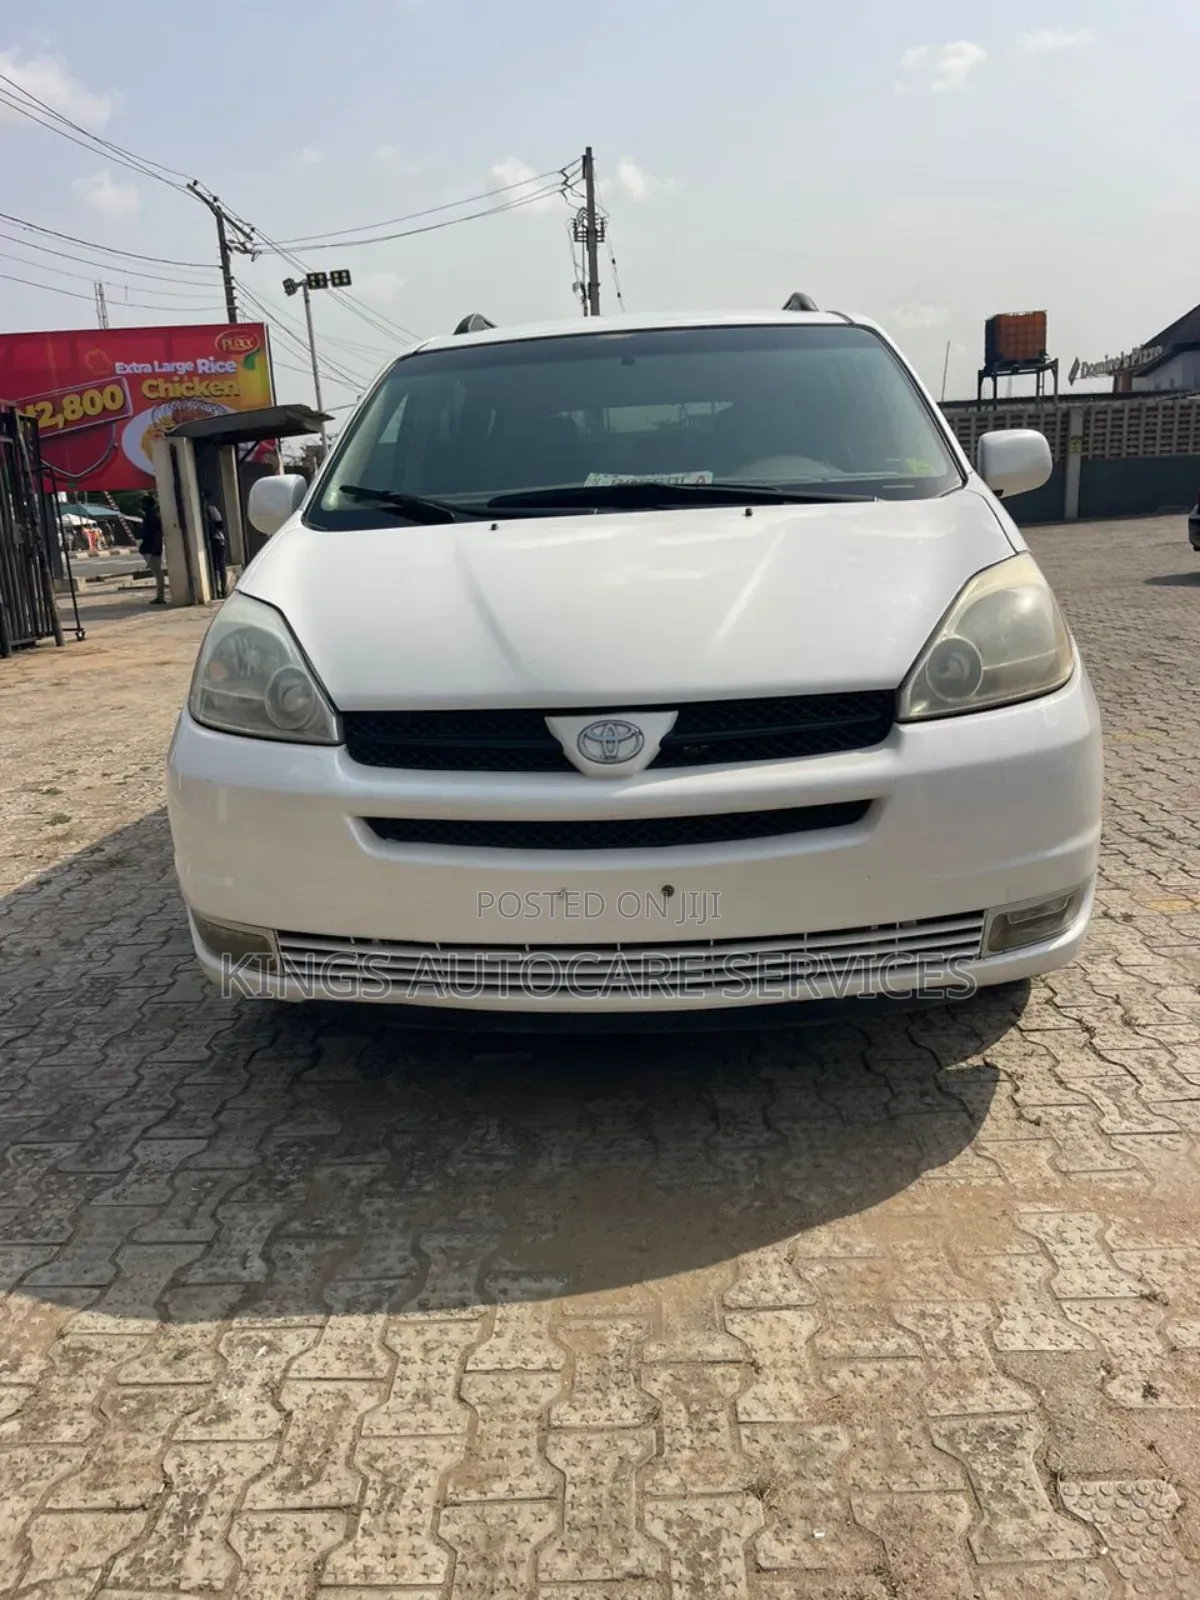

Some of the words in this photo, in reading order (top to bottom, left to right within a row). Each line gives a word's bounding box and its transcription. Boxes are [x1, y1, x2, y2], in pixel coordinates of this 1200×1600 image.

[115, 361, 152, 374] Extra
[153, 360, 194, 375] Large
[196, 356, 237, 374] Rice
[141, 376, 239, 399] Chicken
